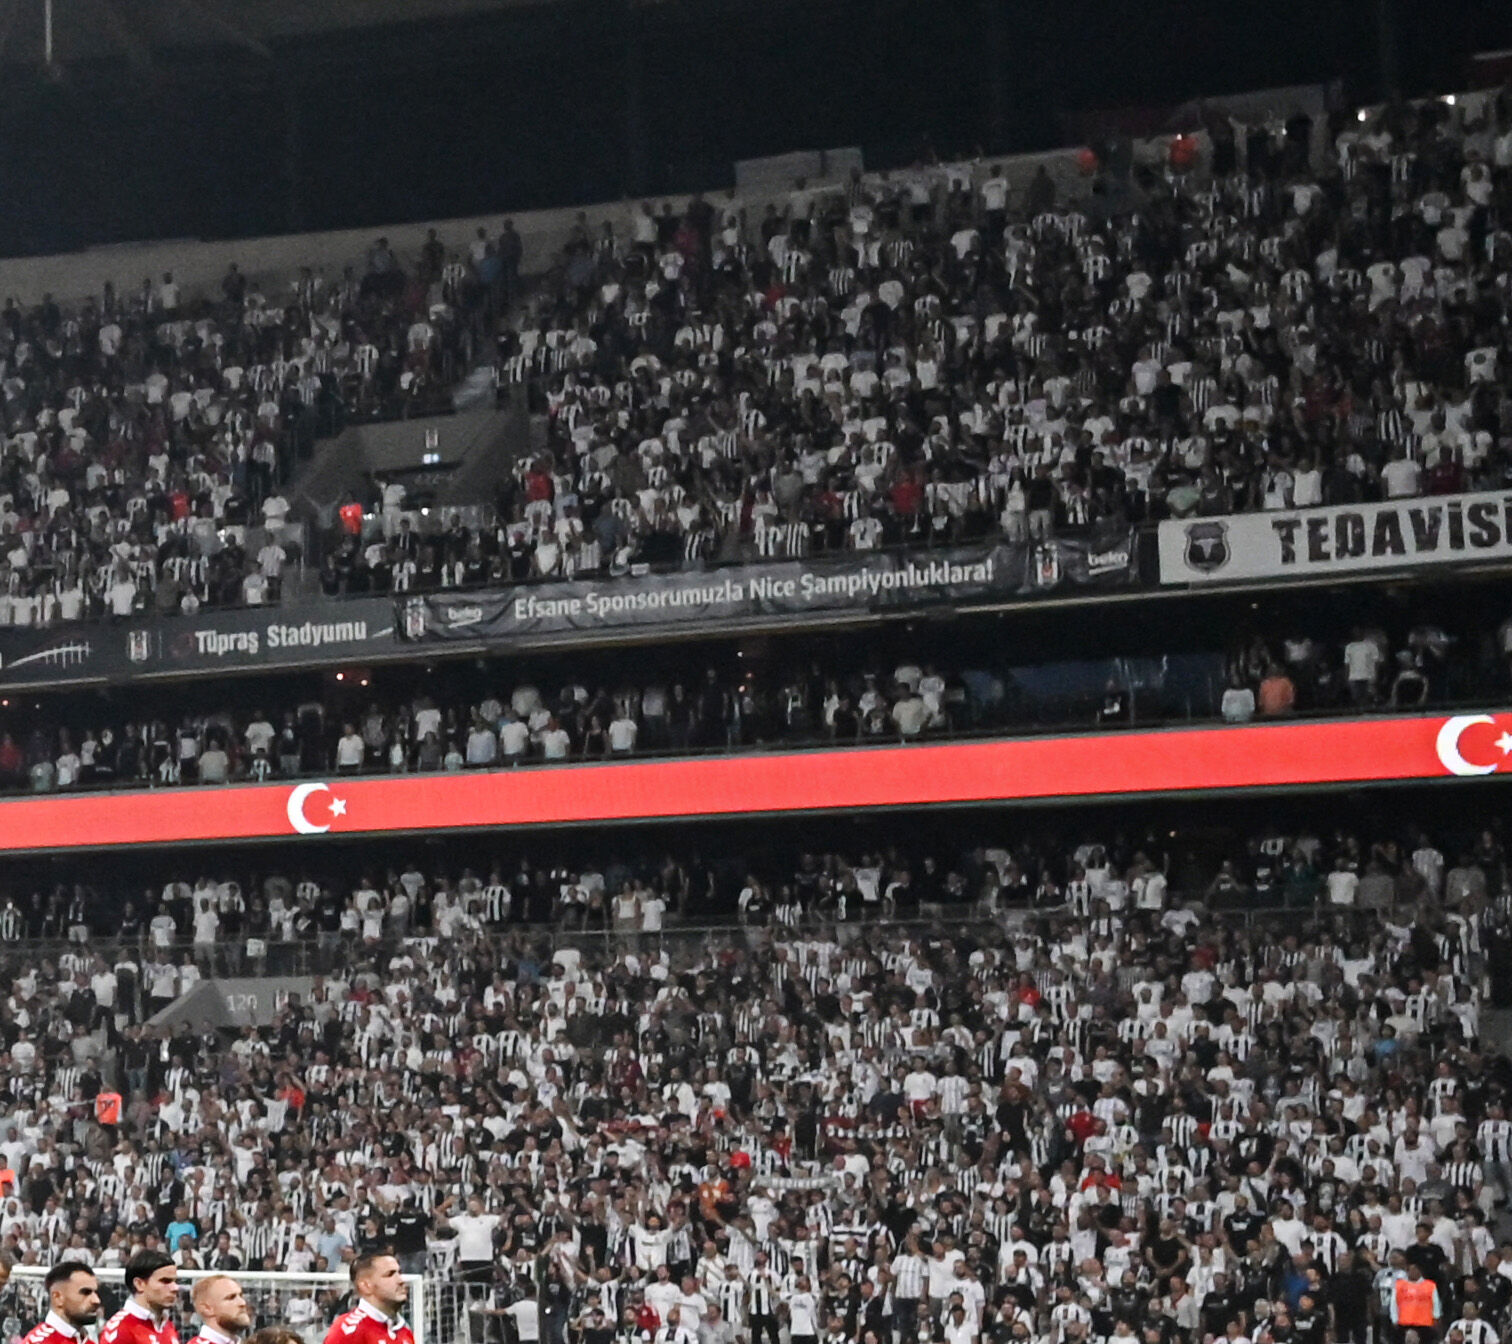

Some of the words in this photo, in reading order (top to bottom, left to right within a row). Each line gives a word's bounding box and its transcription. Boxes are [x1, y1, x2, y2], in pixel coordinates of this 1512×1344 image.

[514, 596, 581, 621] Efsane
[586, 579, 744, 618] Sponsorumuzla
[750, 576, 795, 600] Nice
[800, 558, 995, 600] Şampiyonluklara!
[195, 629, 258, 656] Tüpraş
[267, 621, 367, 648] Stadyumu
